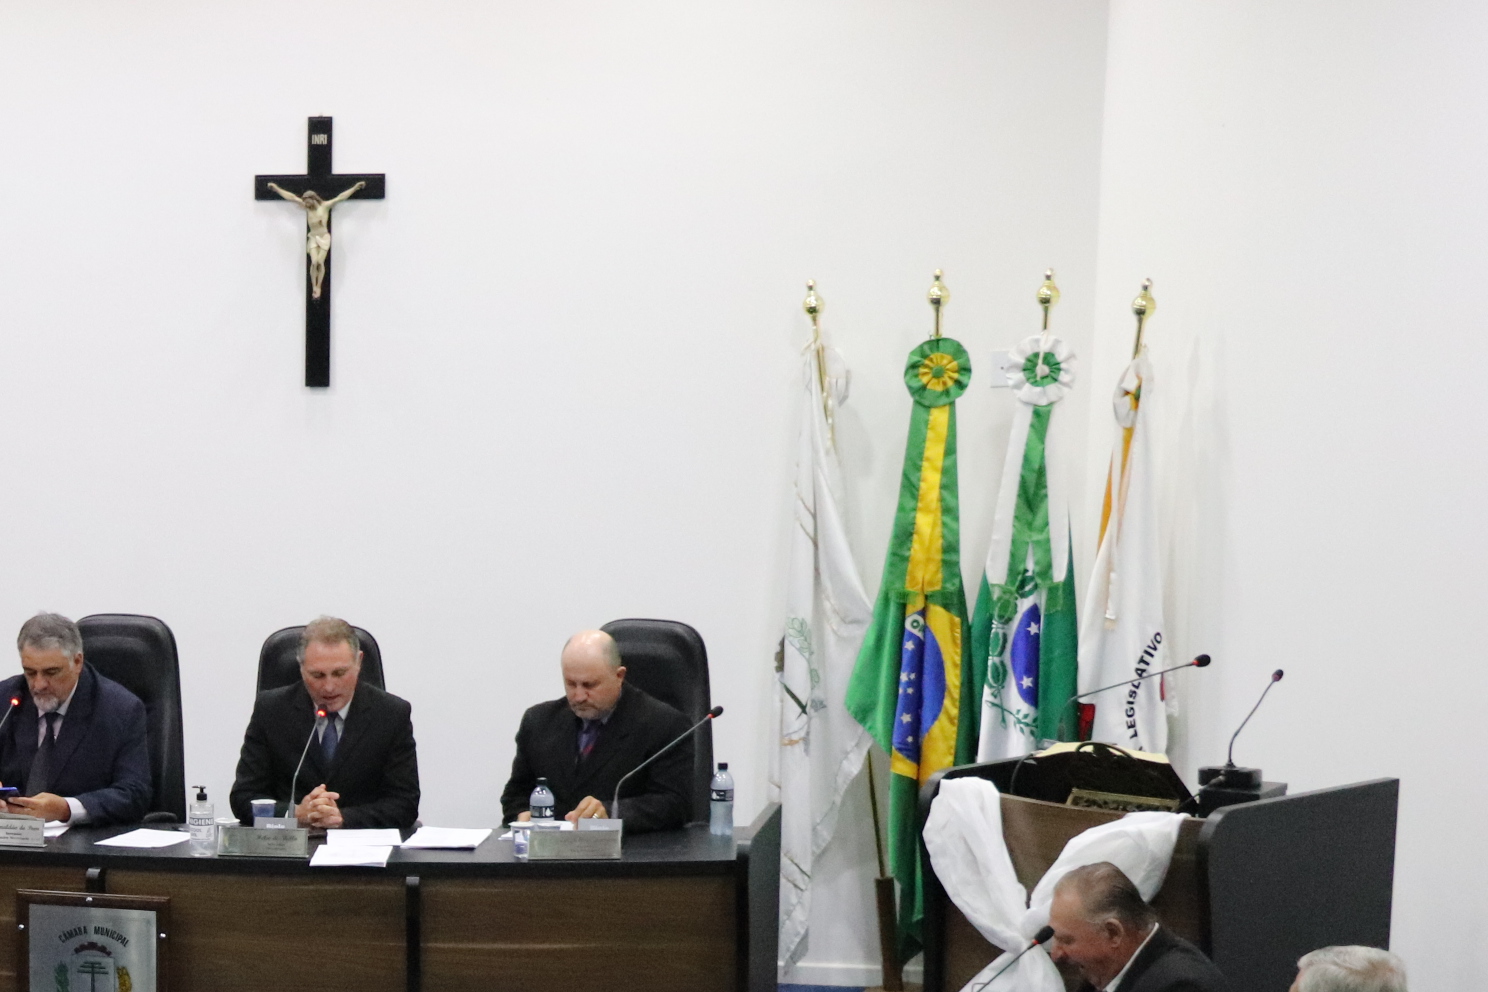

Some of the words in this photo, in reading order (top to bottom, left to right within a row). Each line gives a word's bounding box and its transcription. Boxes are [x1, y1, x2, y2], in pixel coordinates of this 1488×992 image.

[311, 133, 328, 145] INRI
[1125, 632, 1163, 740] LEGISLATIVO
[93, 926, 129, 947] MUNICIPAL
